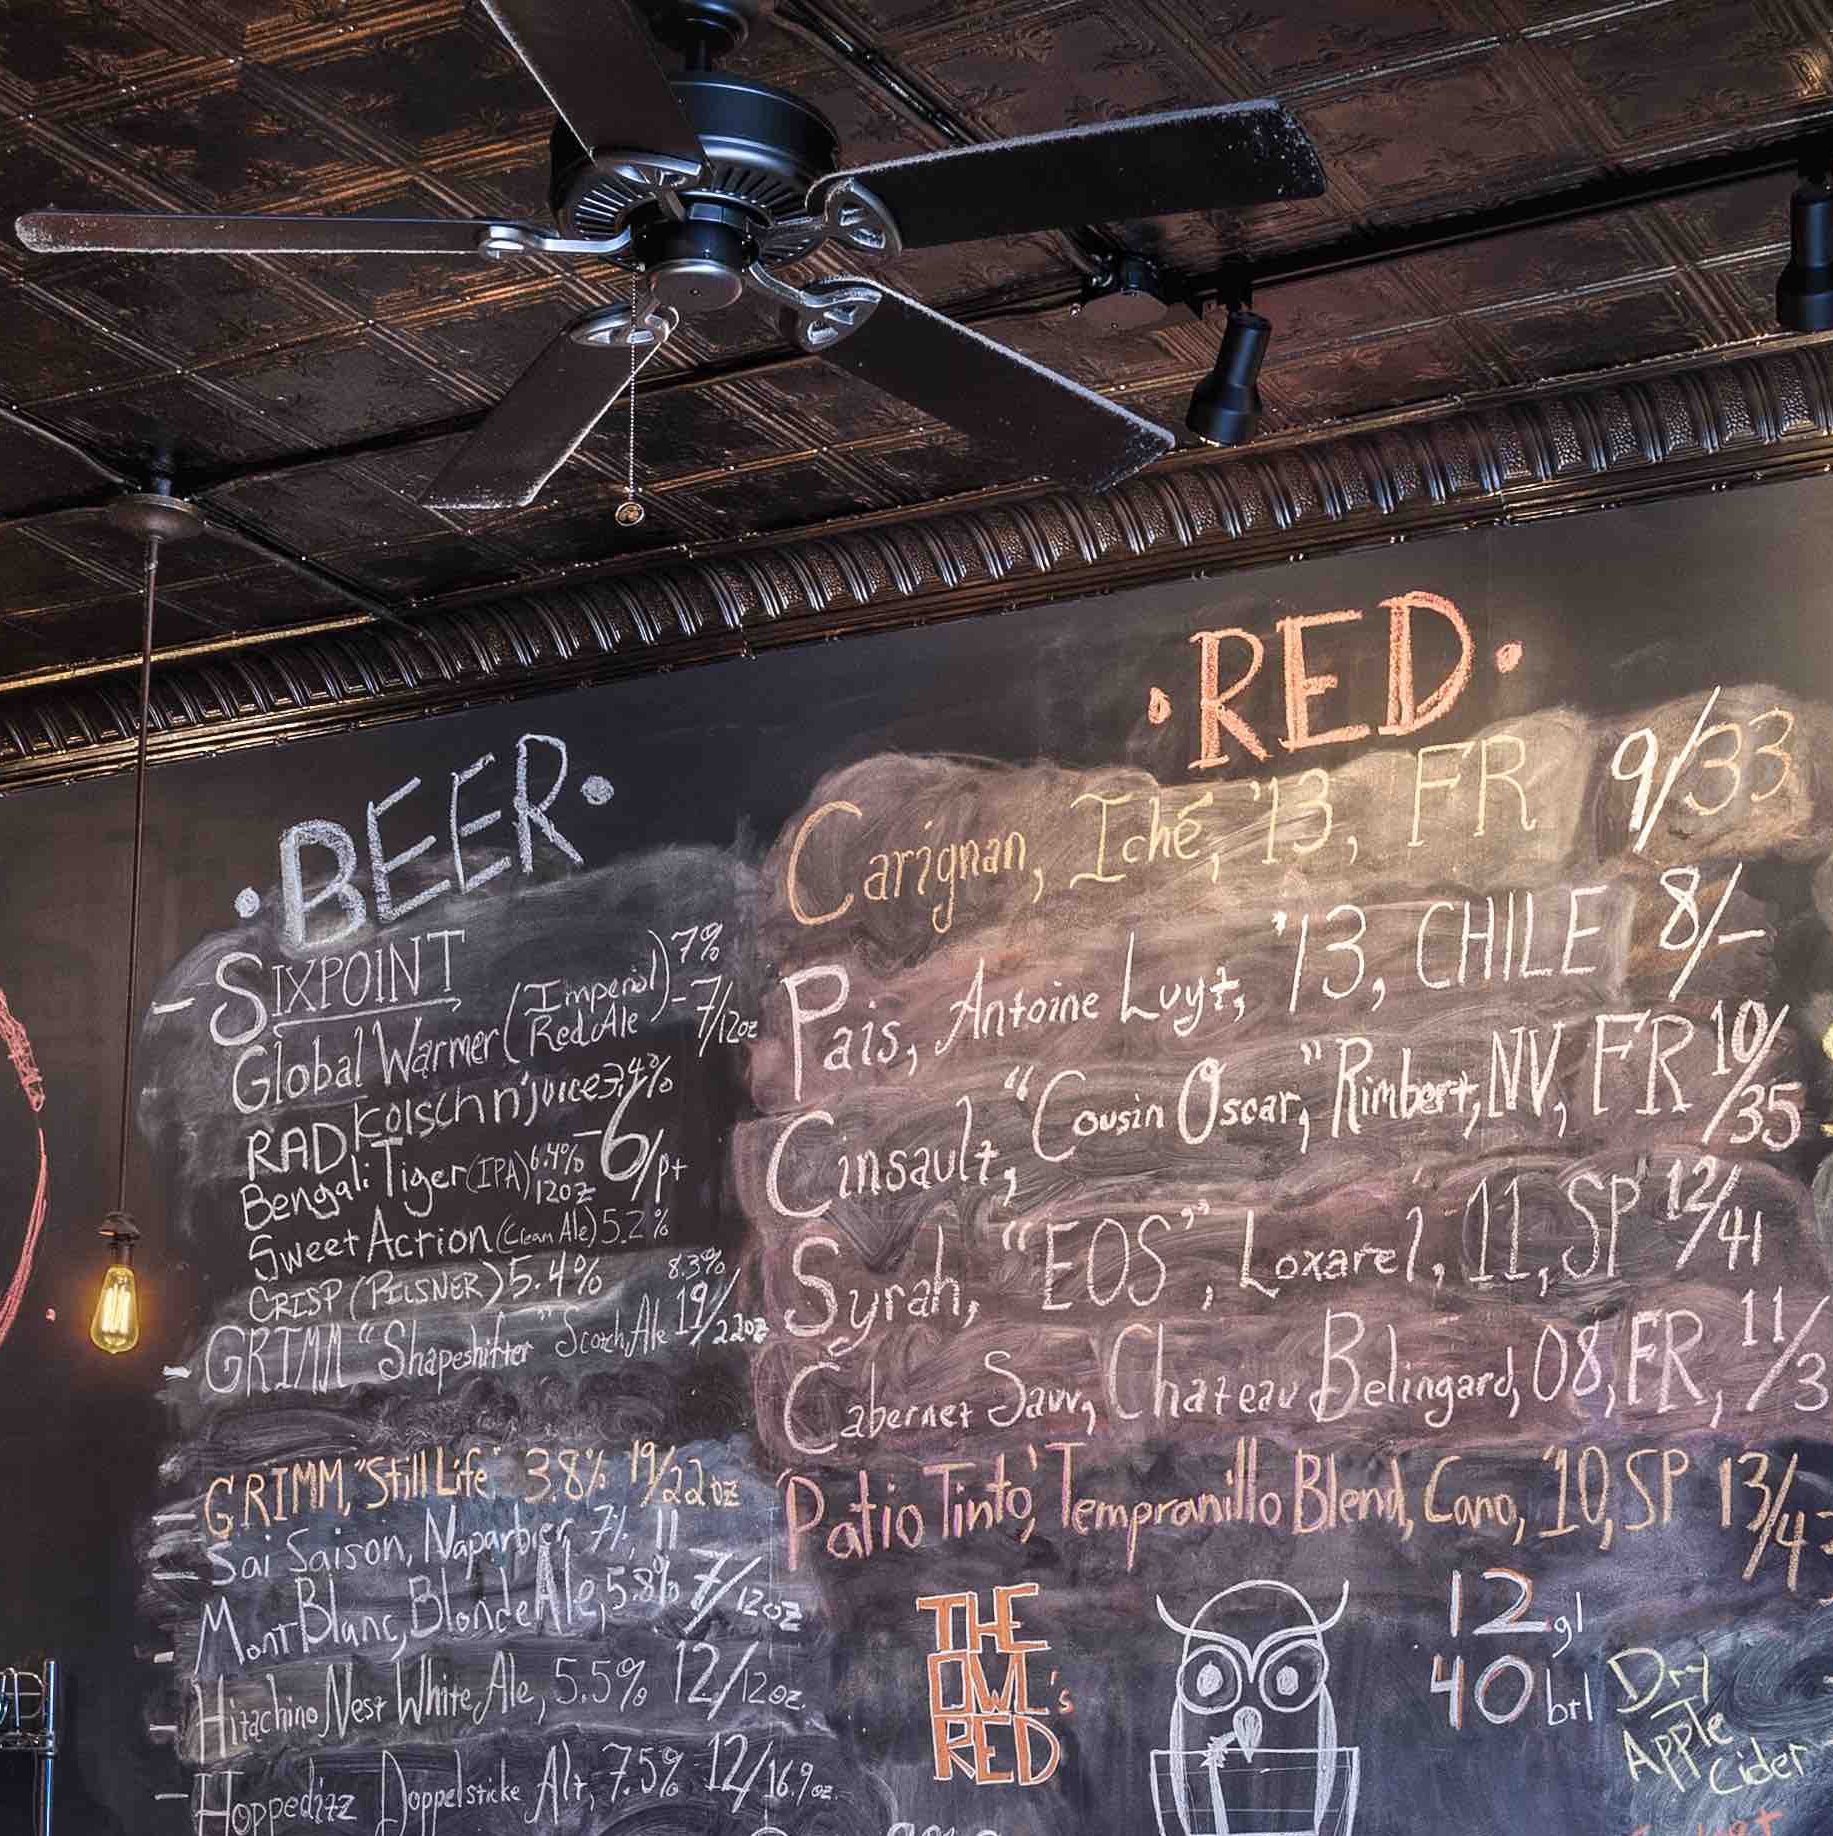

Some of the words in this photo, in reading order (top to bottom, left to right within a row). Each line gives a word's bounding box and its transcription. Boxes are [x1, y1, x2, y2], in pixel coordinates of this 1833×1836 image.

[1189, 590, 1473, 768] RED
[279, 734, 584, 951] BEER
[787, 800, 1045, 934] Carignan,
[1408, 734, 1537, 847] FR
[1611, 685, 1795, 854] 9/33
[935, 957, 1100, 1054] Antoine
[1416, 885, 1609, 990] CHILE
[232, 1026, 364, 1114] Global
[372, 1016, 499, 1088] Warmer
[671, 922, 723, 964] 7%
[1593, 1008, 1695, 1118] FR
[246, 1121, 348, 1181] RAD
[369, 1136, 467, 1218] Tiger
[248, 1228, 360, 1282] Sweet
[367, 1204, 494, 1264] Action
[602, 1208, 670, 1245] 5.2%
[1562, 1173, 1640, 1279] SP
[249, 1279, 343, 1323] CRISP
[509, 1250, 602, 1299] 5.4%
[206, 1323, 349, 1397] GRIMM
[784, 1361, 973, 1455] Cabernet
[1109, 1322, 1294, 1420] Chateau
[1046, 1437, 1281, 1571] Tempranillo
[1625, 1449, 1689, 1532] SP
[206, 1534, 270, 1586] Sai
[1447, 1567, 1551, 1637] 12
[192, 1596, 299, 1684] Mont
[409, 1567, 531, 1639] Blonde
[916, 1583, 1051, 1652] THE
[191, 1672, 318, 1765] Hitachino
[318, 1660, 388, 1739] Nest
[395, 1652, 472, 1726] White
[555, 1656, 647, 1712] 5.5%
[1430, 1654, 1534, 1730] 40
[1607, 1647, 1710, 1713] Dry
[932, 1713, 1062, 1785] RED
